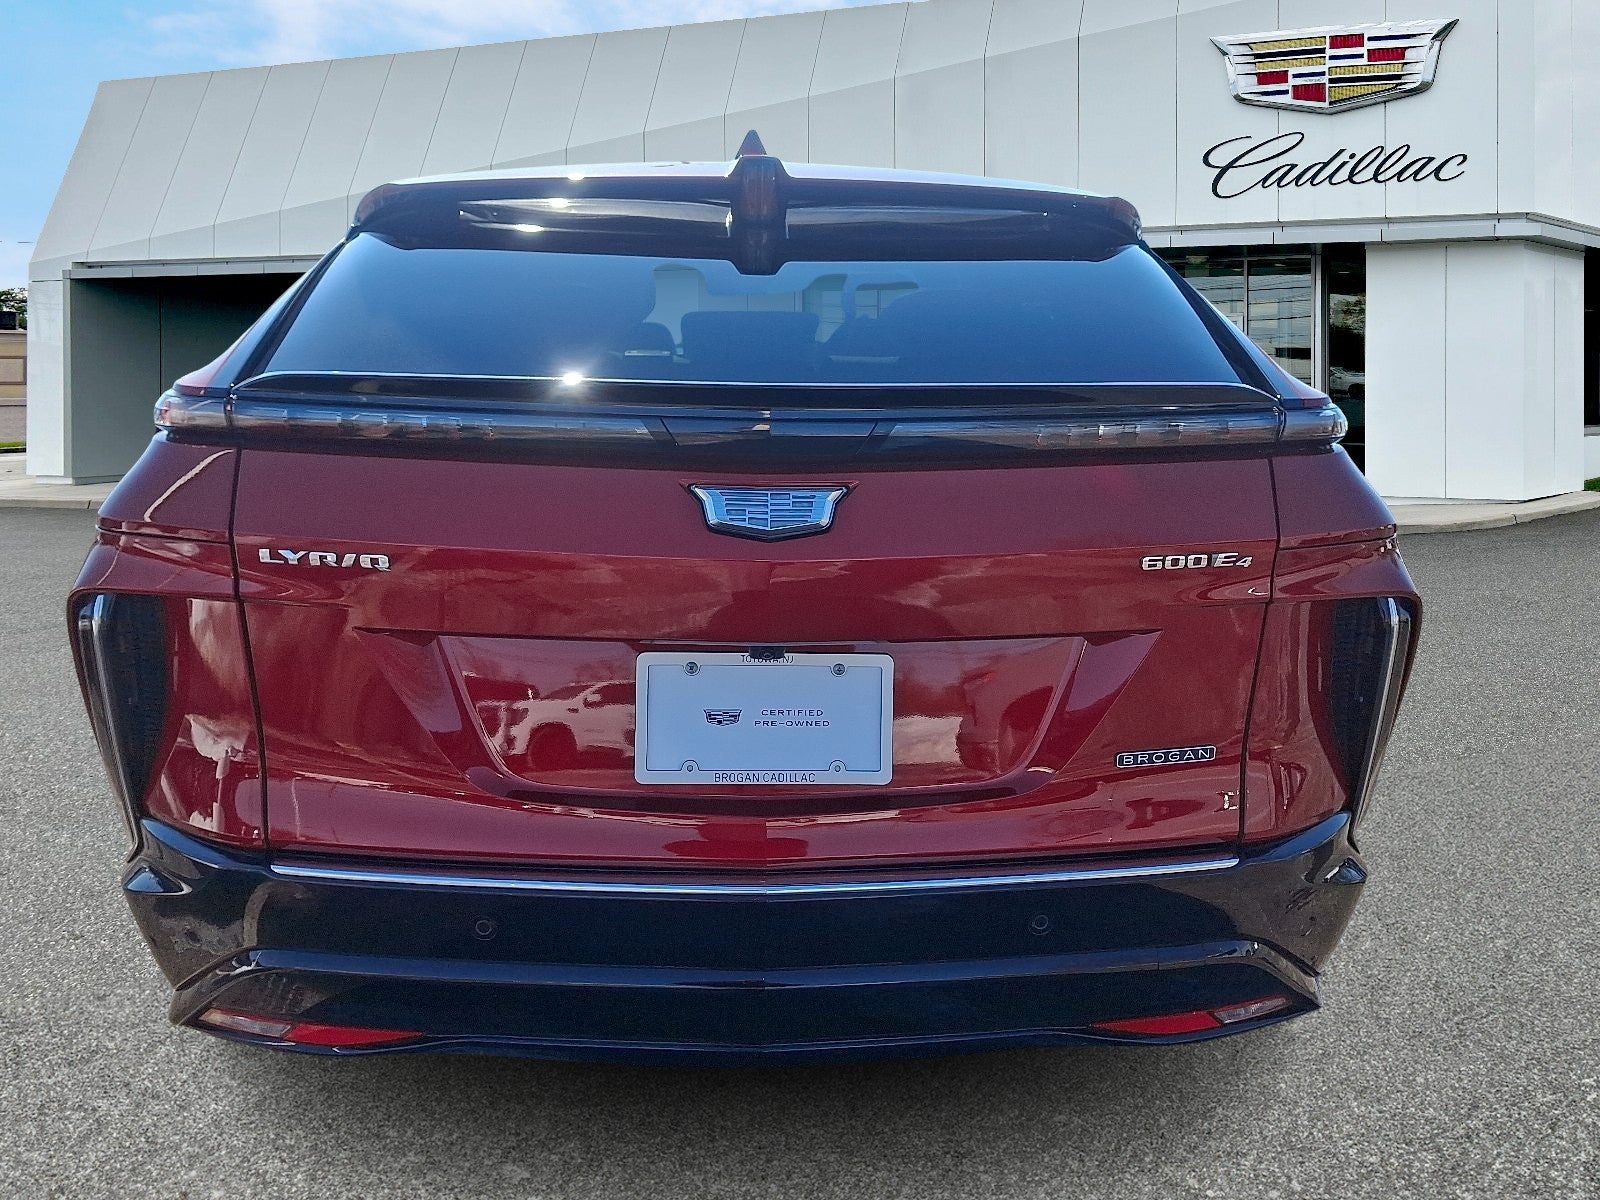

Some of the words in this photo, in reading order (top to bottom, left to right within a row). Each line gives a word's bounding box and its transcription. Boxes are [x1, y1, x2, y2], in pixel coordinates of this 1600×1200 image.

[1202, 131, 1468, 199] Cadillac
[258, 548, 391, 571] LYRIQ
[761, 709, 824, 717] CERTIFIED
[1123, 748, 1210, 765] BROGAN
[714, 772, 760, 783] BROGAN
[762, 772, 816, 783] CADILLAC
